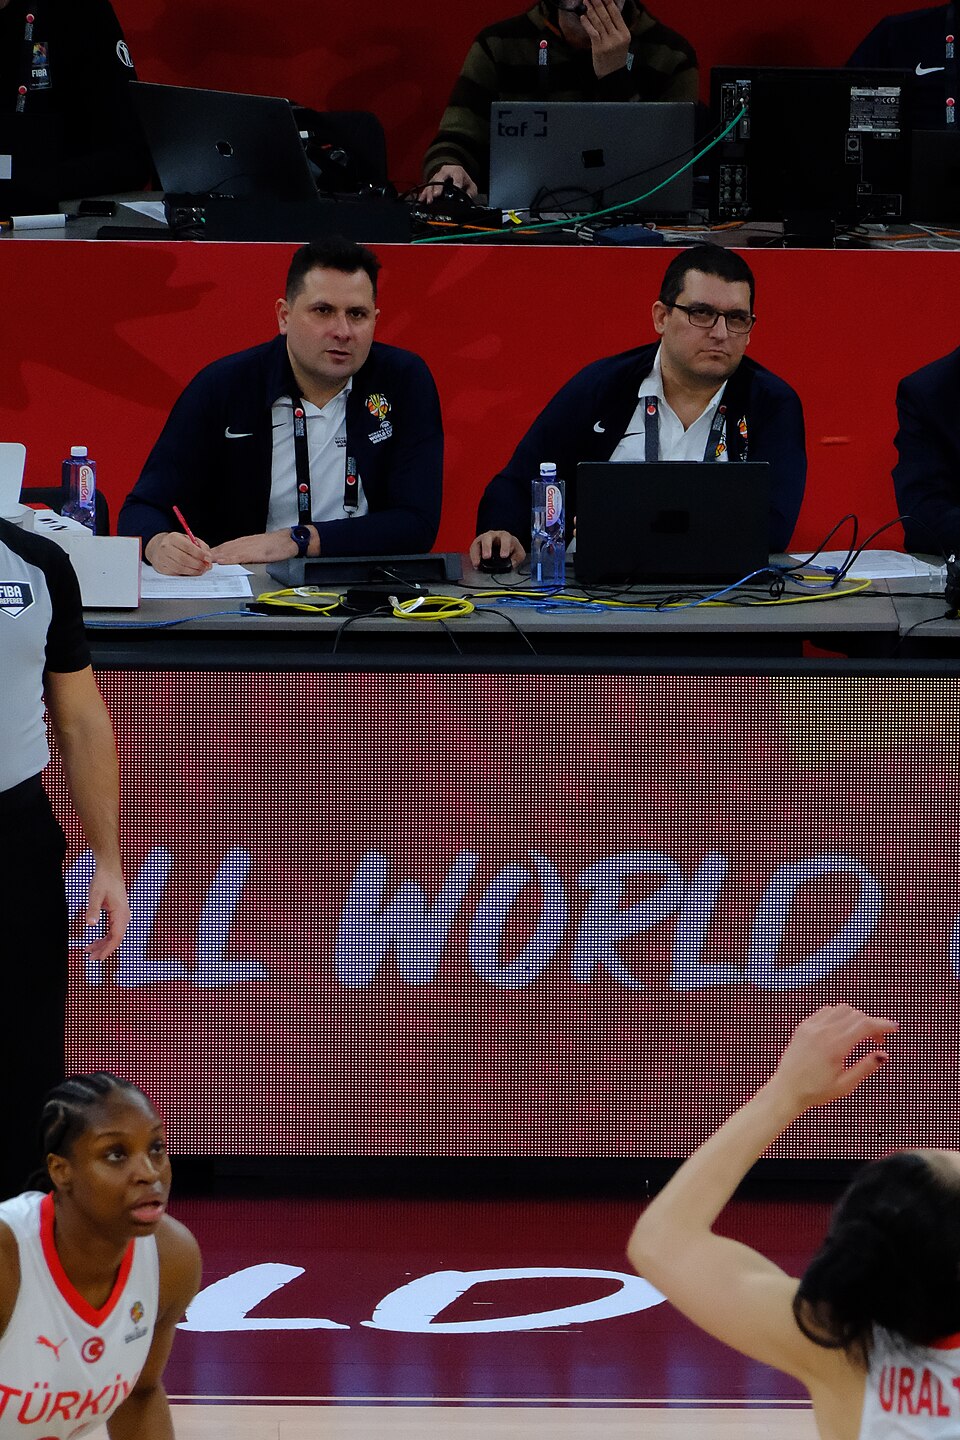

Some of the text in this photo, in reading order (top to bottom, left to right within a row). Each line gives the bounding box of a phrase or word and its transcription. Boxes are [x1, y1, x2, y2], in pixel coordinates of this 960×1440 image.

[498, 122, 528, 137] taf
[0, 585, 23, 598] FIBA
[334, 849, 886, 992] WORLD
[0, 1373, 132, 1424] TÜRKİ
